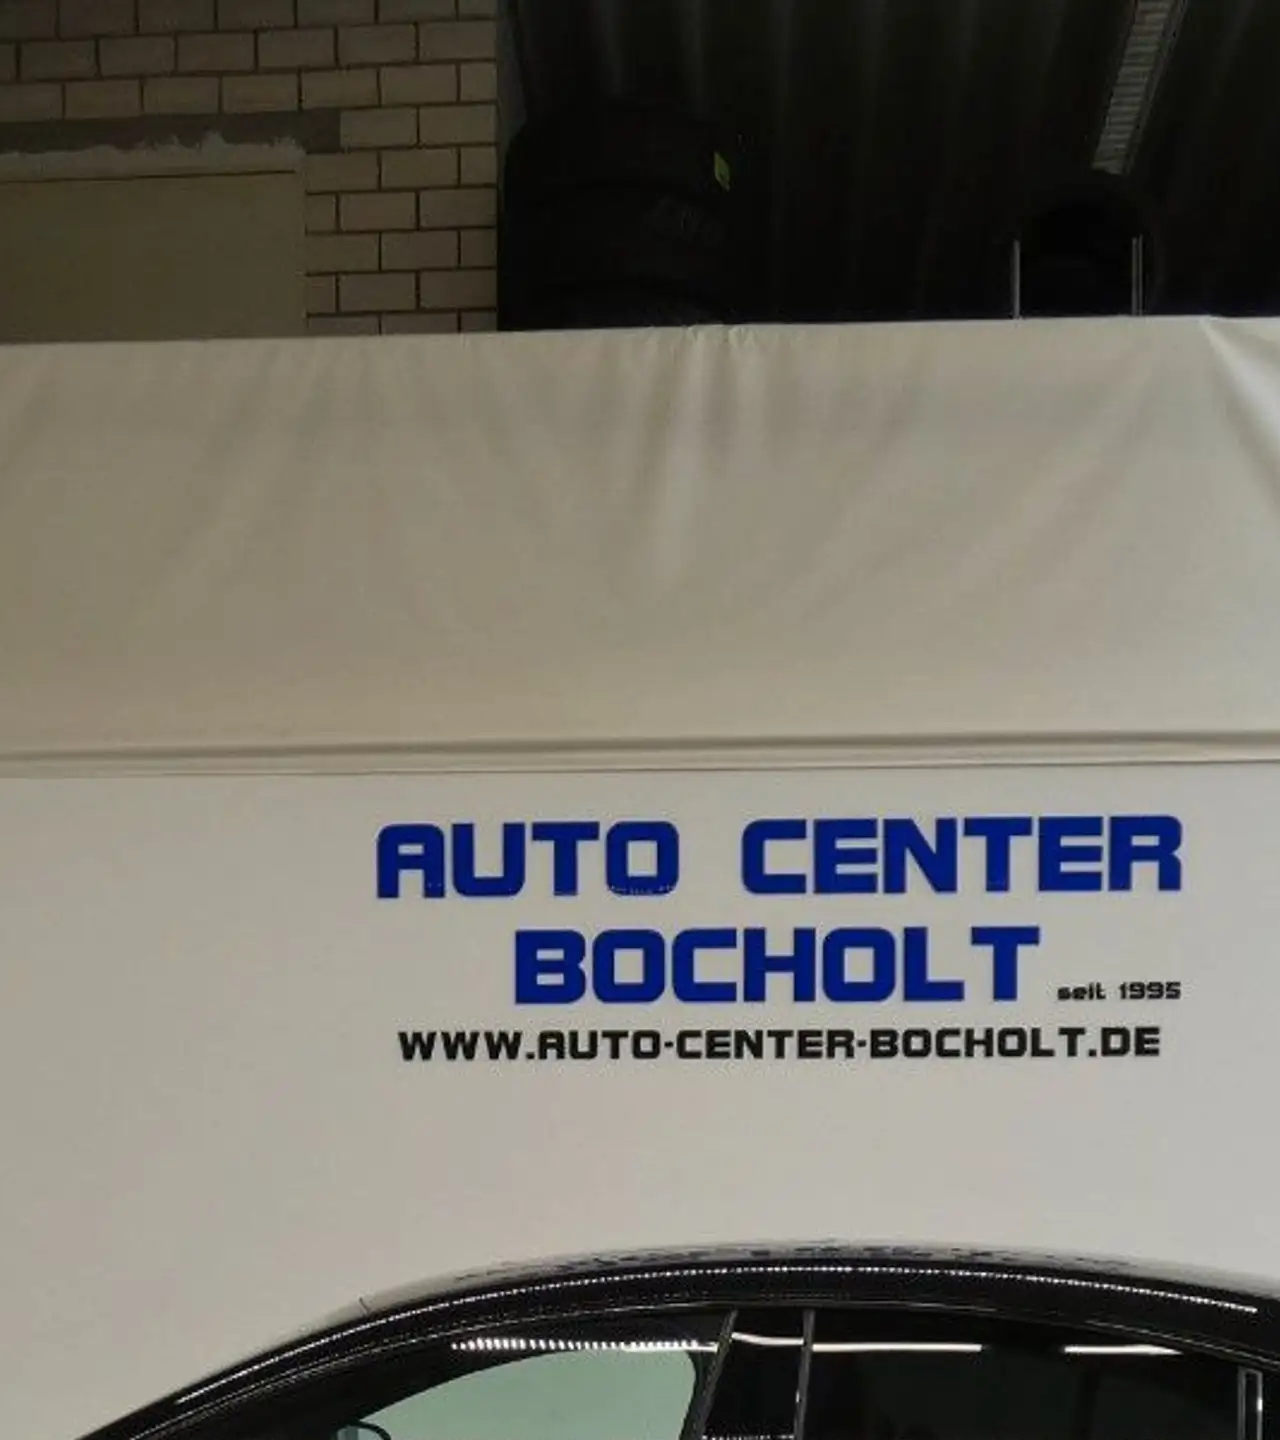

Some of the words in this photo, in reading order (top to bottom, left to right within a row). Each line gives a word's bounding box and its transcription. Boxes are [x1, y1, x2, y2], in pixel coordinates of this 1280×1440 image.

[376, 820, 680, 900] AUTO
[741, 815, 1183, 895] CENTER
[514, 925, 1041, 1005] BOCHOLT
[1057, 981, 1107, 1001] seit
[1119, 981, 1182, 1001] 1995
[397, 1026, 1162, 1062] WWW.AUTO-CENTER-BOCHOLT.DE
